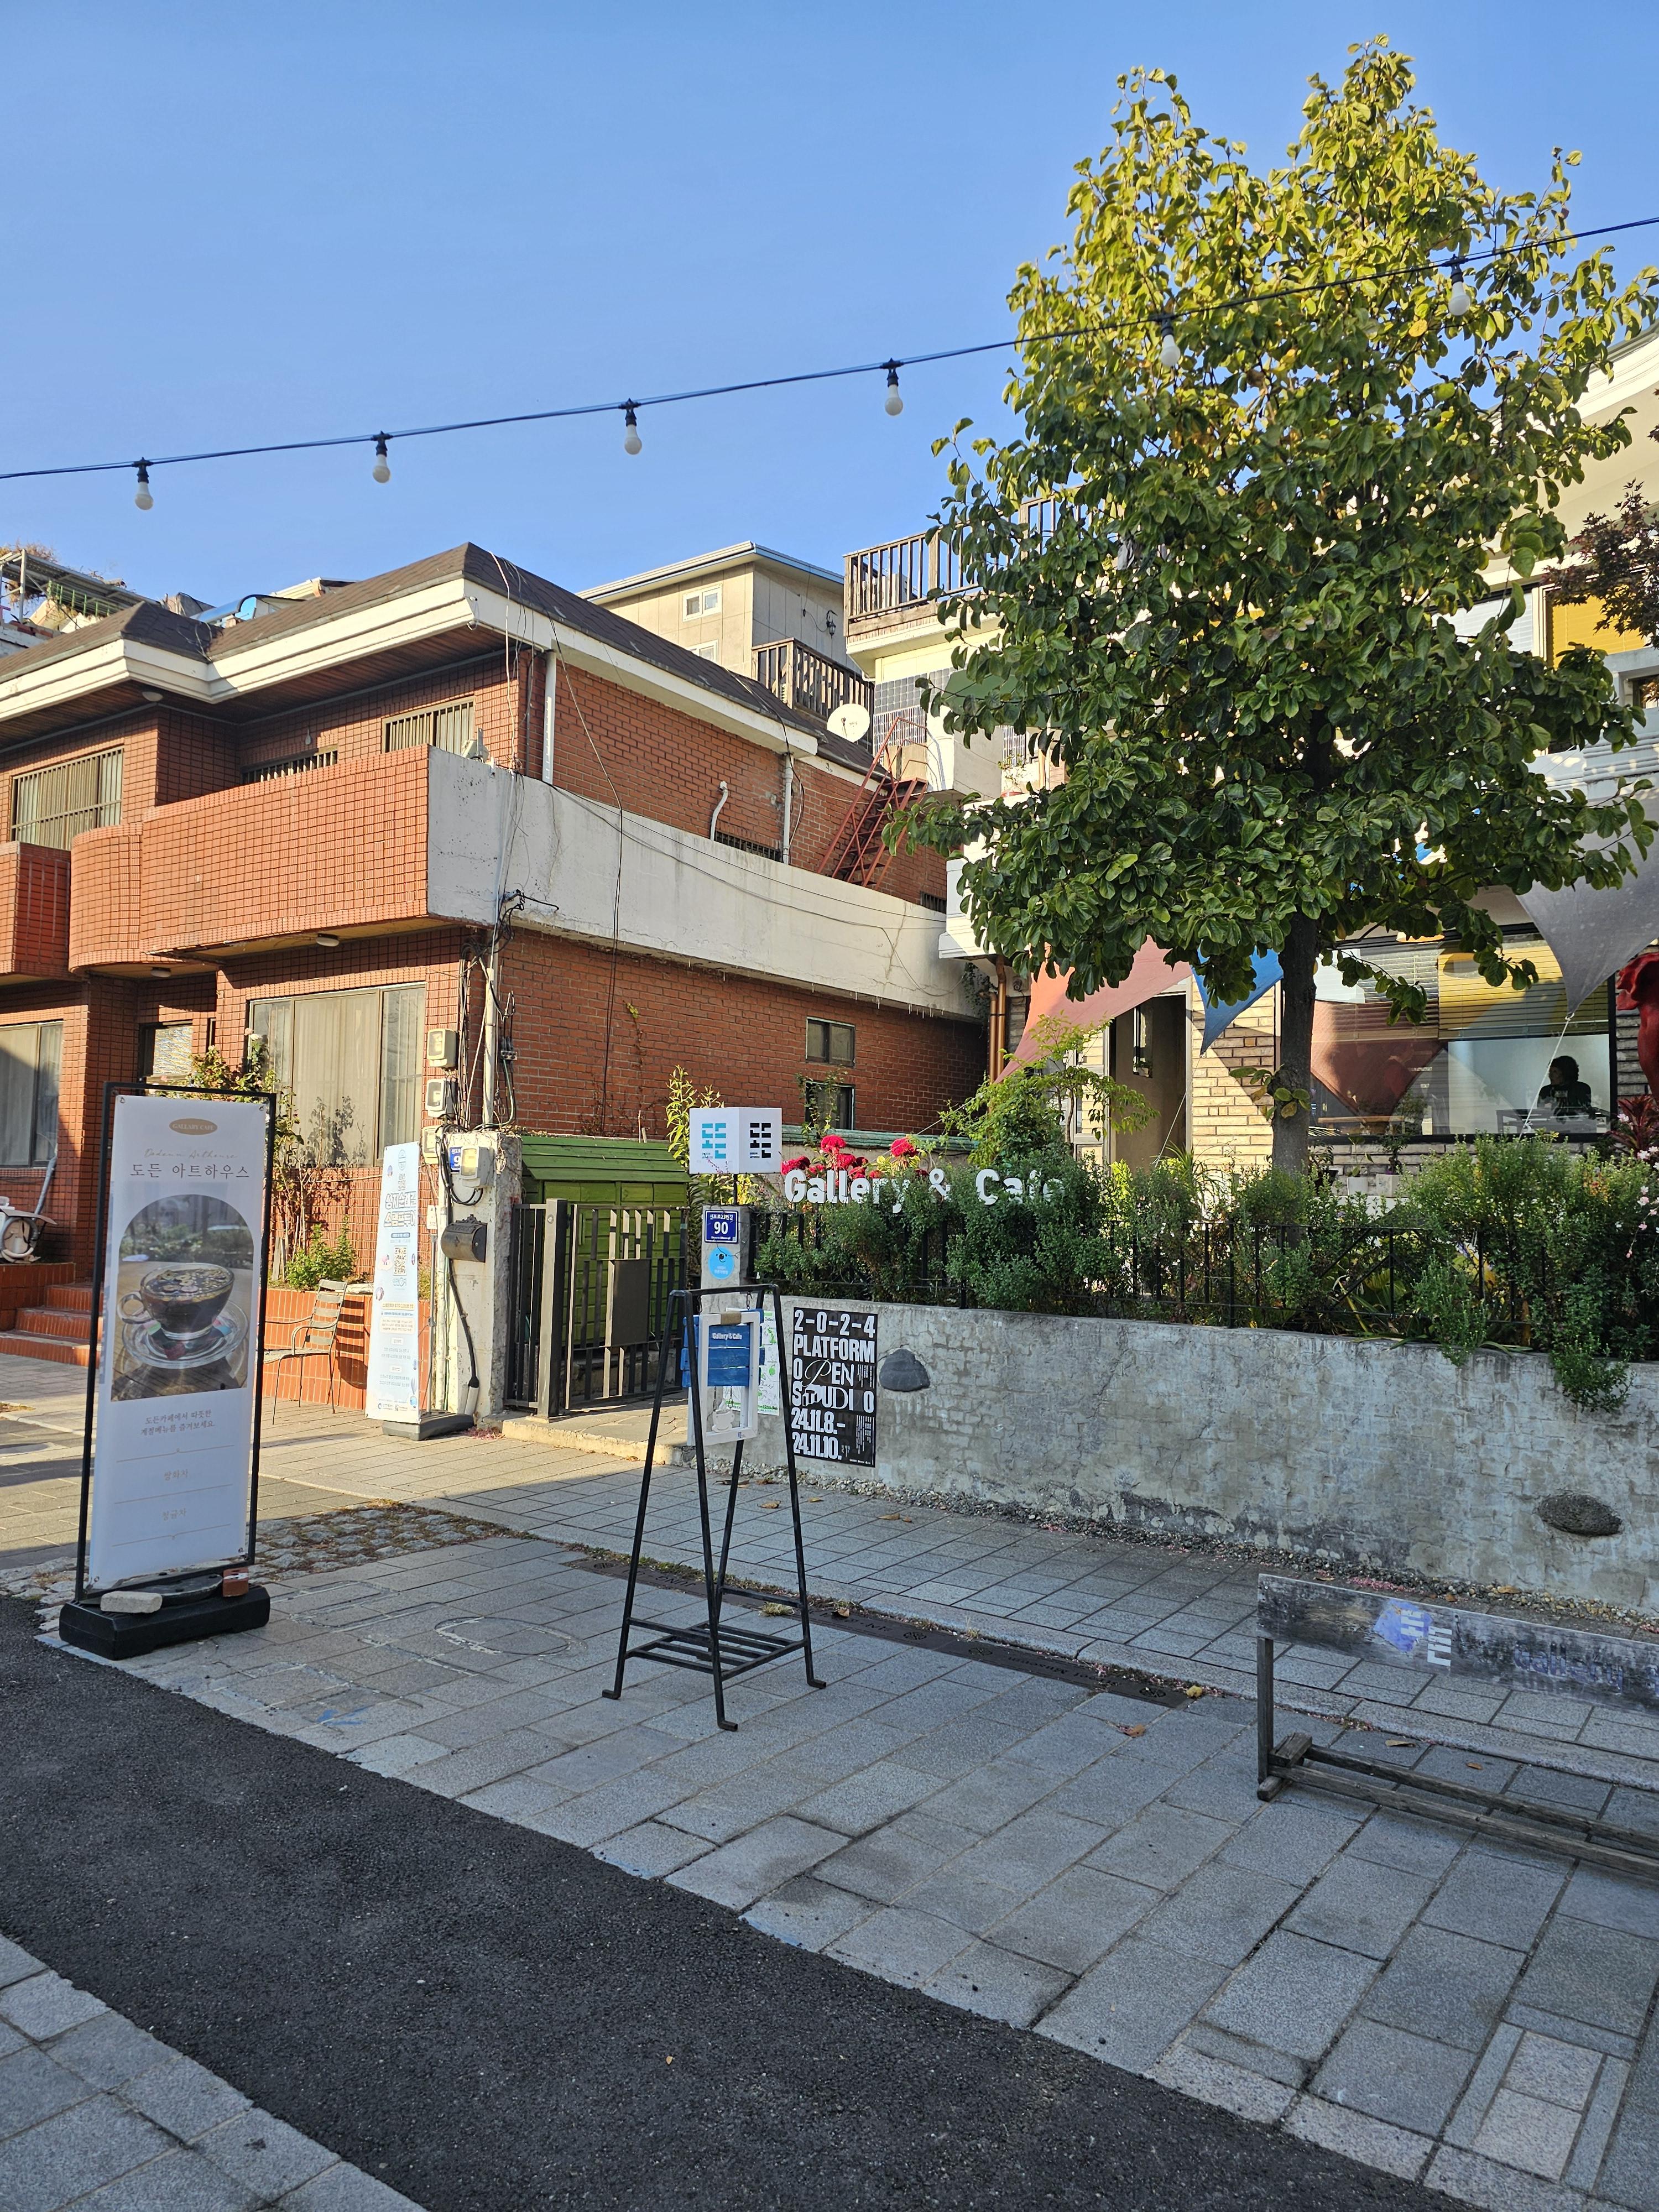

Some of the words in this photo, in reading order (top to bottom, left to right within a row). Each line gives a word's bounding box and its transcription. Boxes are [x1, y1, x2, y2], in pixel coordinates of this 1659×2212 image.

[130, 1164, 162, 1178] 도든
[172, 1163, 249, 1179] 아트하우스
[785, 1169, 910, 1213] Gallery
[714, 1221, 729, 1234] 90
[794, 1333, 875, 1364] PLATFORM
[793, 1358, 854, 1387] OPEN
[145, 1412, 188, 1425] 도든카페에서
[191, 1410, 212, 1419] 따뜻한
[792, 1431, 842, 1460] 24.11.10.
